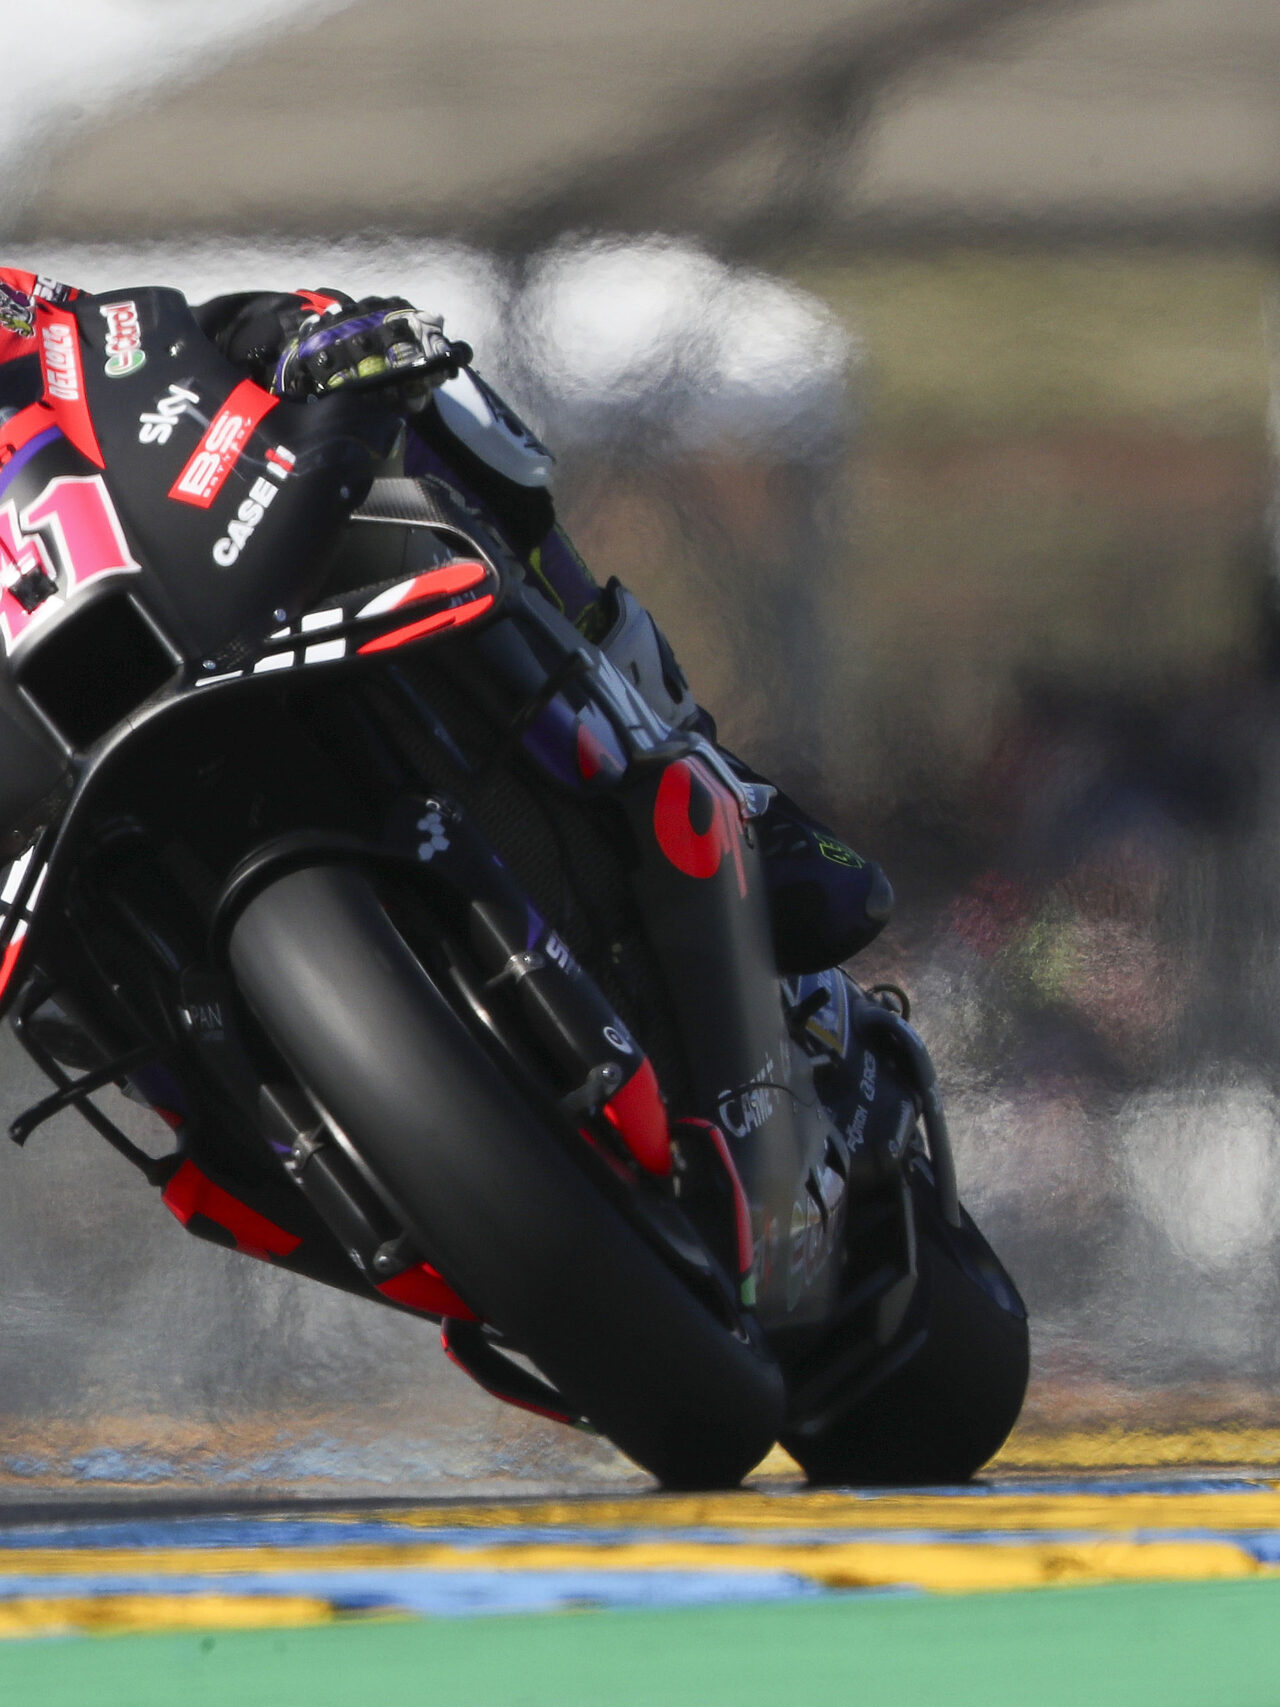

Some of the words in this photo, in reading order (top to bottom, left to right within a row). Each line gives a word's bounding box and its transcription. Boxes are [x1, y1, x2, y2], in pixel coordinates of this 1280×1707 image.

[139, 384, 200, 445] sky
[178, 411, 244, 496] BS
[212, 476, 279, 567] CASE
